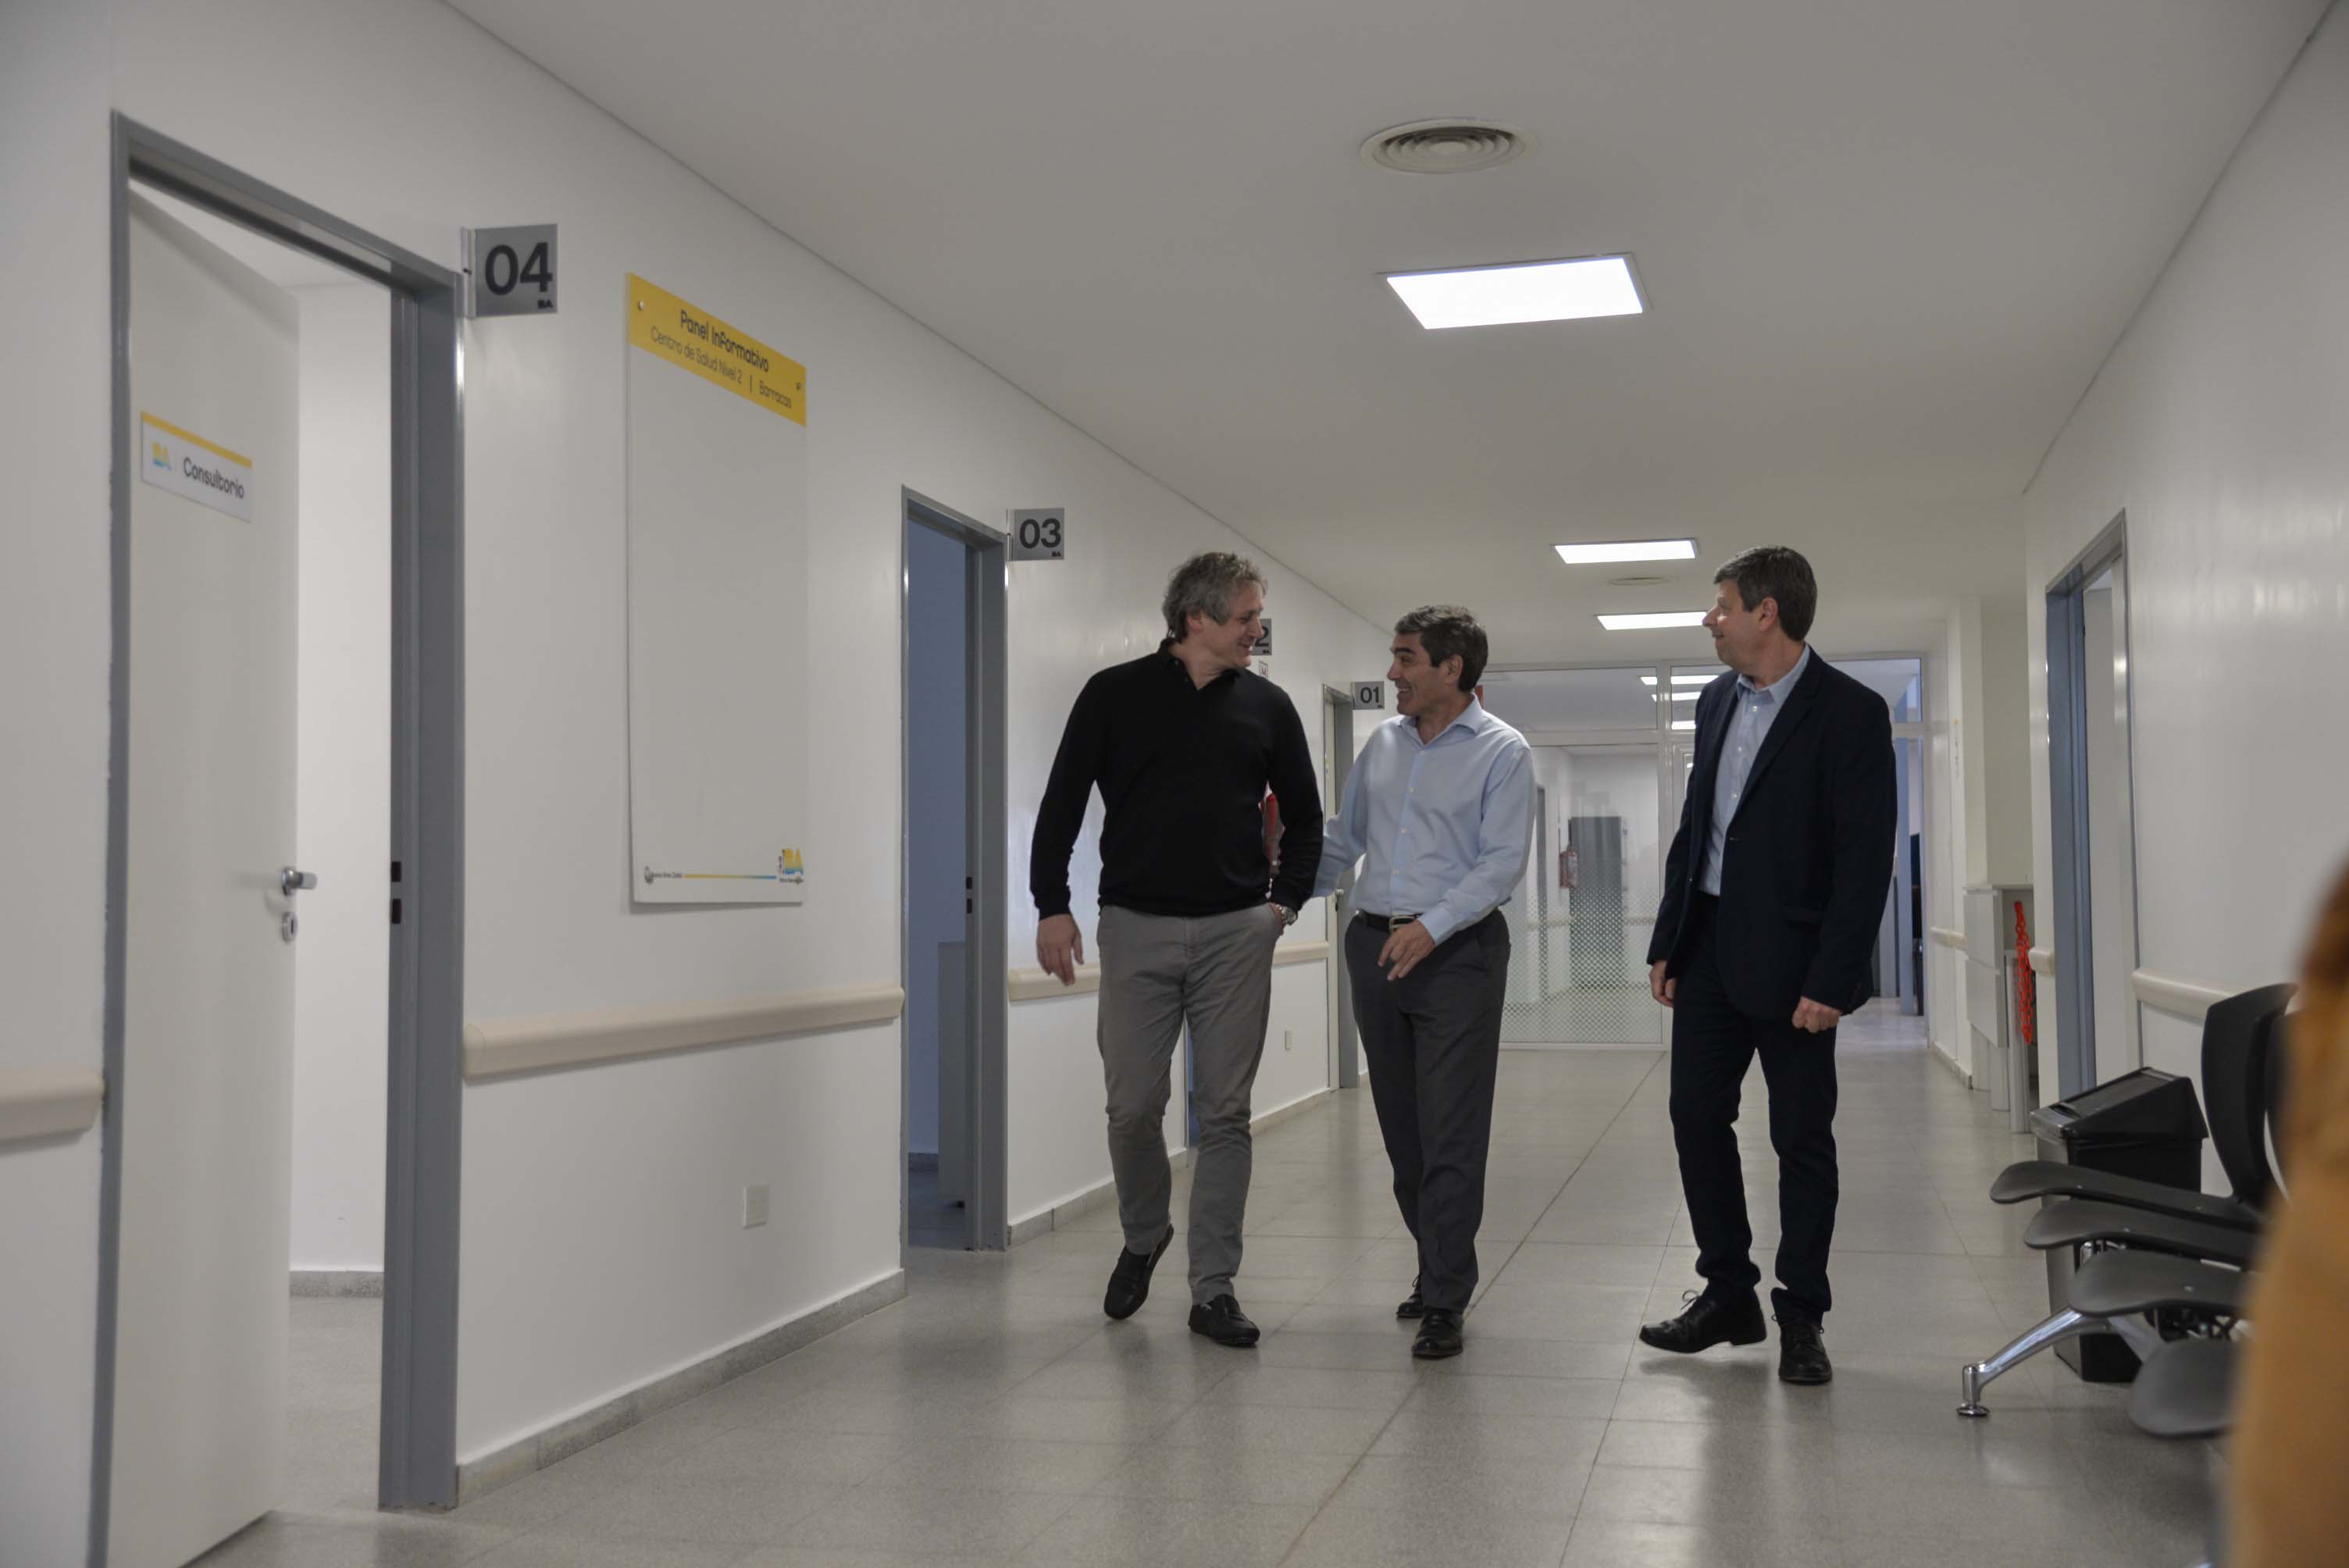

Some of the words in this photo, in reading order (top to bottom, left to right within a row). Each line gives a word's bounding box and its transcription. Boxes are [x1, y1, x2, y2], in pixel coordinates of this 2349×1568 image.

[485, 242, 553, 296] 04
[680, 309, 709, 341] Panel
[712, 325, 769, 372] Informativo
[684, 344, 694, 360] de
[697, 347, 717, 371] Salud
[719, 360, 736, 382] Nivel
[737, 369, 743, 384] 2
[759, 380, 792, 408] Barracas
[183, 456, 244, 500] Consultorio
[1020, 518, 1062, 549] 03
[1360, 686, 1379, 704] 01
